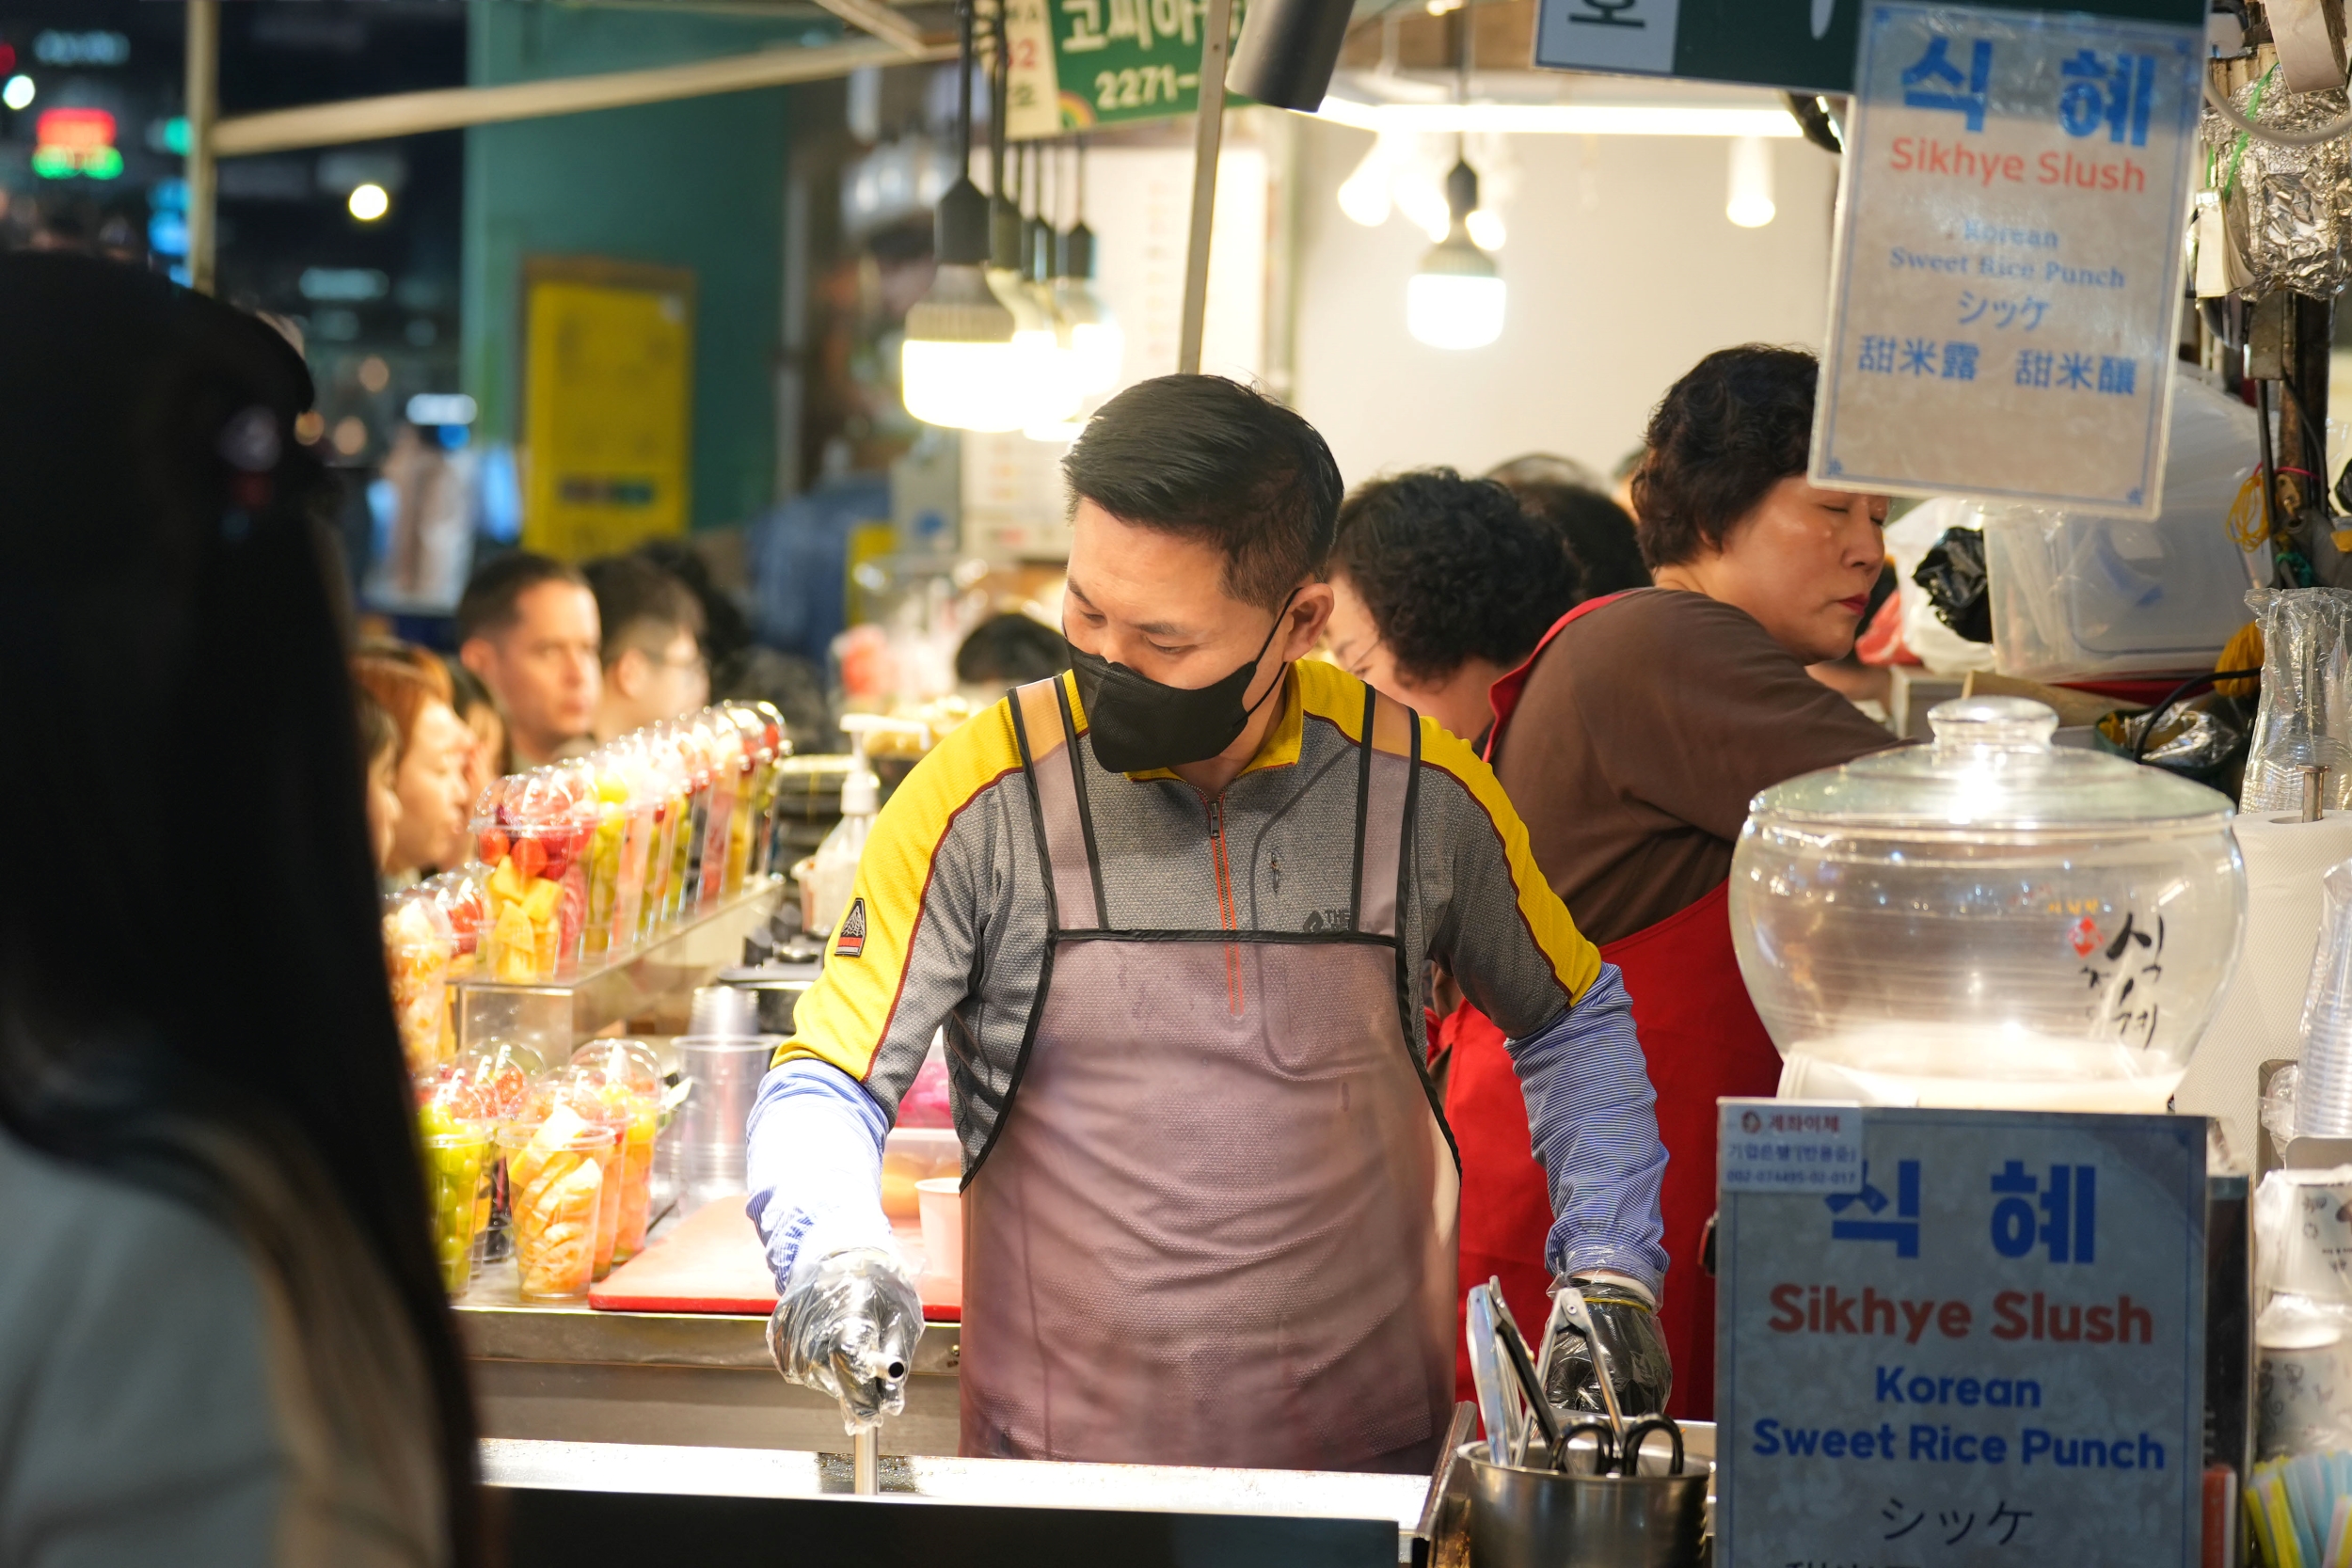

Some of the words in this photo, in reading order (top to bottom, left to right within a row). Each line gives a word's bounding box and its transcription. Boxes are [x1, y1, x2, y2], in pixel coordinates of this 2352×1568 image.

[1889, 136, 2025, 188] Sikhye
[2037, 149, 2146, 194] Slush
[1963, 220, 2058, 248] Korean
[1890, 245, 1969, 274] Sweet
[1979, 255, 2036, 279] Rice
[2045, 261, 2126, 289] Punch
[1958, 289, 2050, 332] シッケ
[1325, 909, 1351, 924] THE
[1766, 1282, 1973, 1346] Sikhye
[1989, 1289, 2153, 1345] Slush
[1875, 1365, 2042, 1408] Korean
[1751, 1418, 1896, 1462] Sweet
[1908, 1423, 2008, 1465] Rice
[2021, 1428, 2166, 1470] Punch
[1881, 1497, 2034, 1547] シッケ
